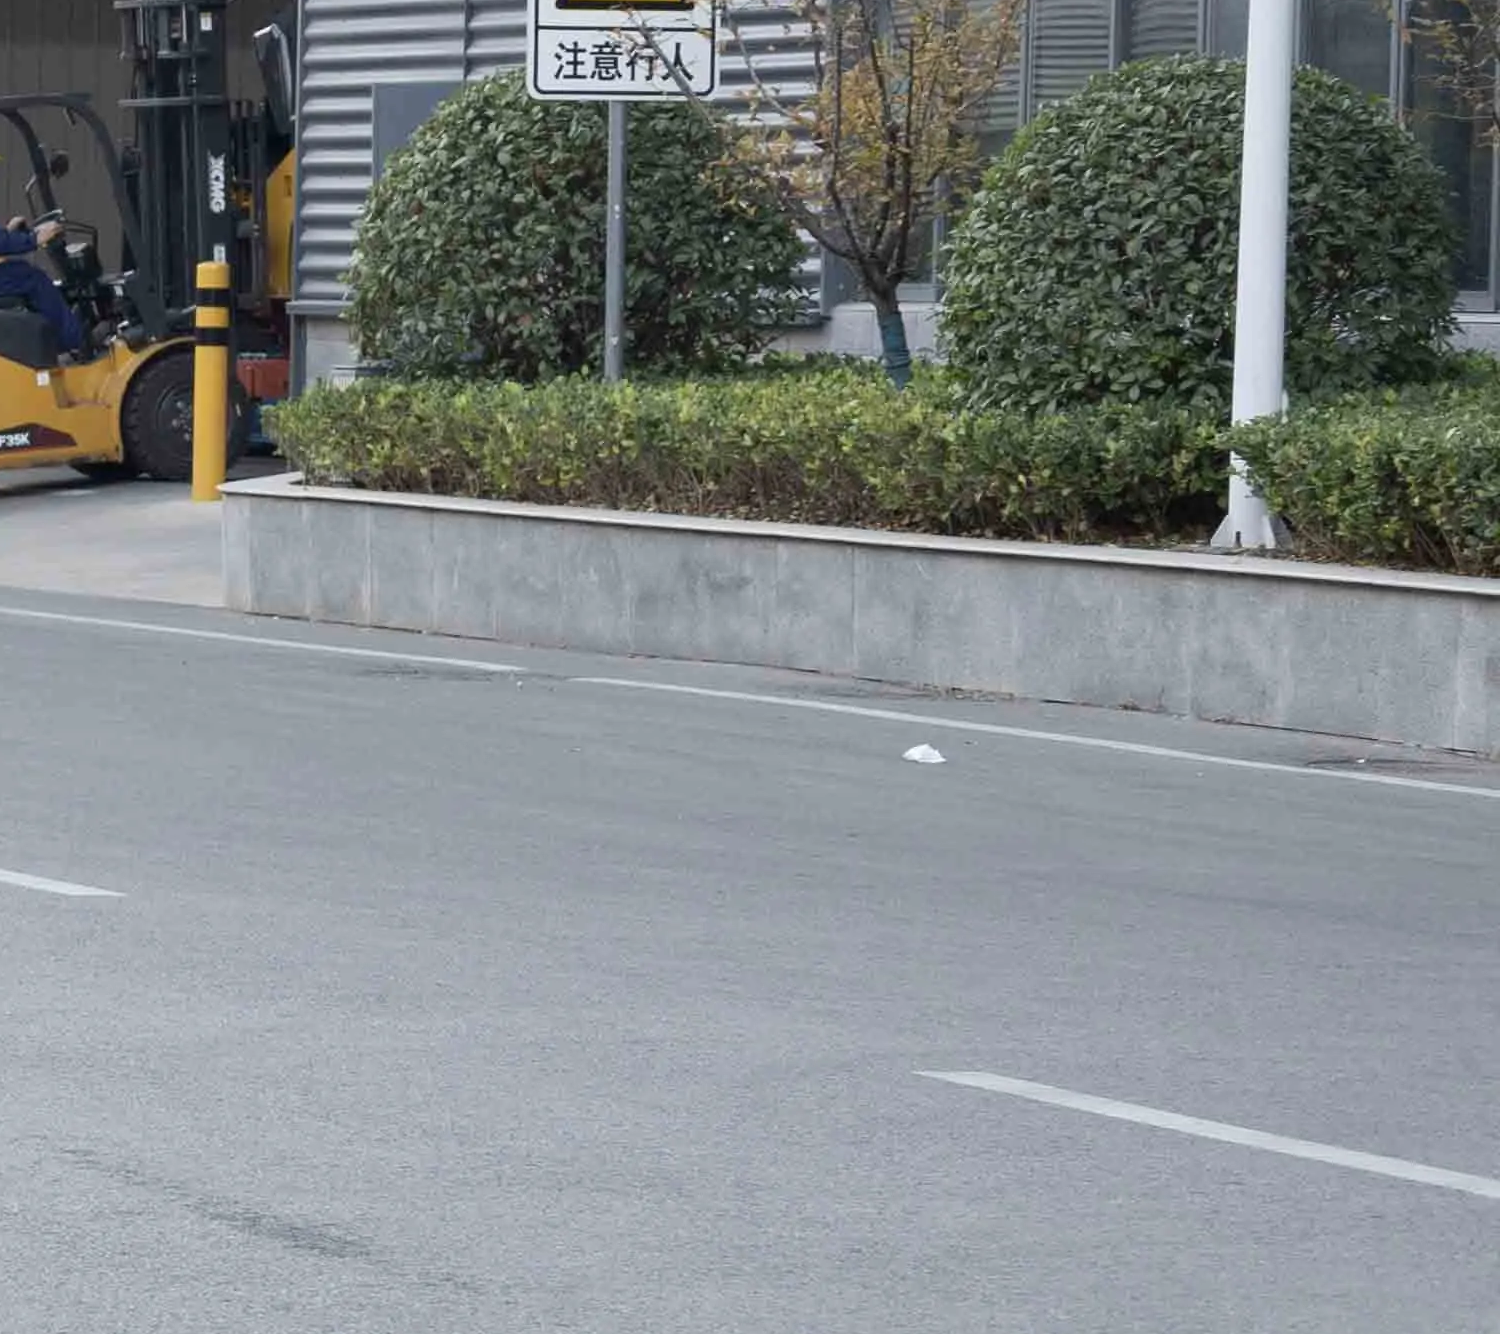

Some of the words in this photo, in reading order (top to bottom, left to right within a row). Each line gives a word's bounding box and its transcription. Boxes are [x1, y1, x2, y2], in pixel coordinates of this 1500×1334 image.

[553, 41, 694, 81] 注意行人
[207, 150, 226, 214] XCMG
